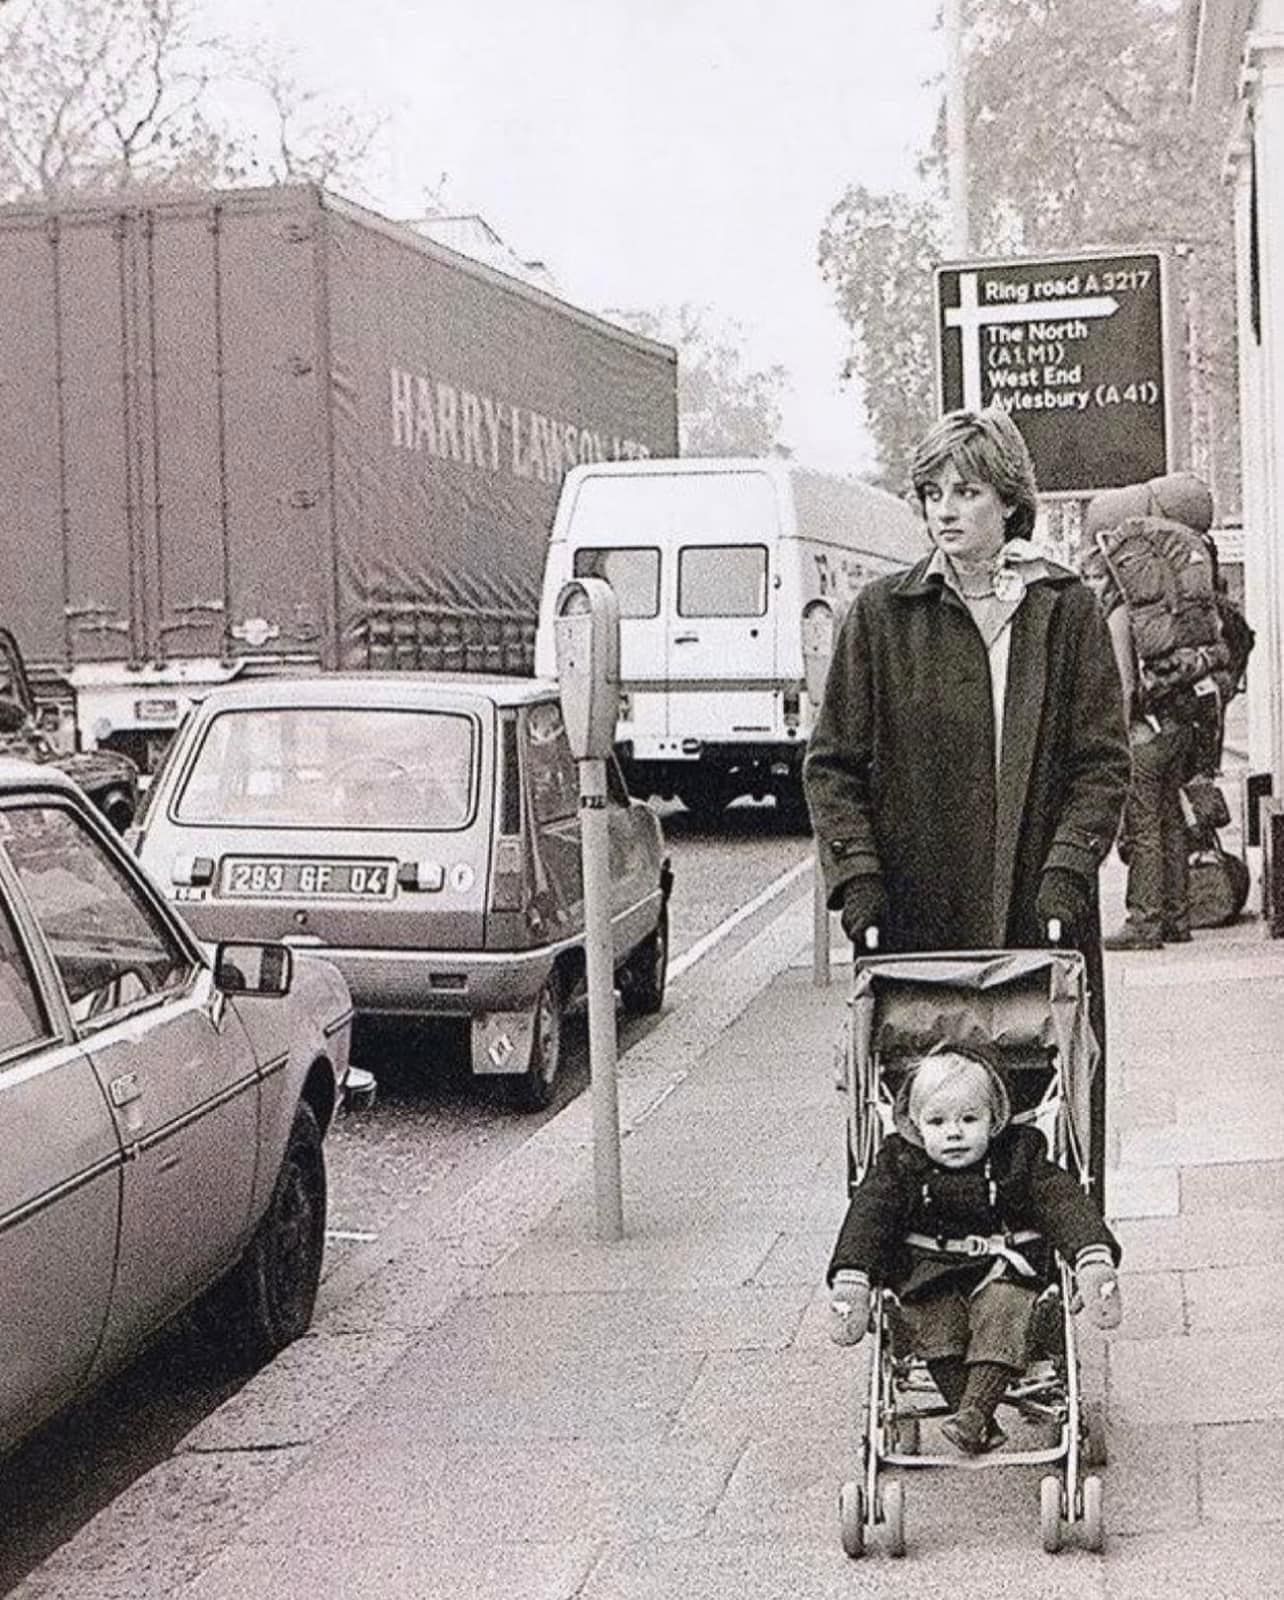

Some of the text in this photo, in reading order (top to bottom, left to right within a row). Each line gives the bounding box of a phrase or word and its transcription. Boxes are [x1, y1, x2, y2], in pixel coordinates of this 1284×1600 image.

[985, 280, 1029, 302] Ring
[1034, 275, 1079, 297] road
[987, 320, 1088, 344] The North
[987, 365, 1082, 388] West End
[990, 388, 1091, 413] Aylesbury
[390, 366, 507, 471] HARRY
[351, 868, 385, 893] 04
